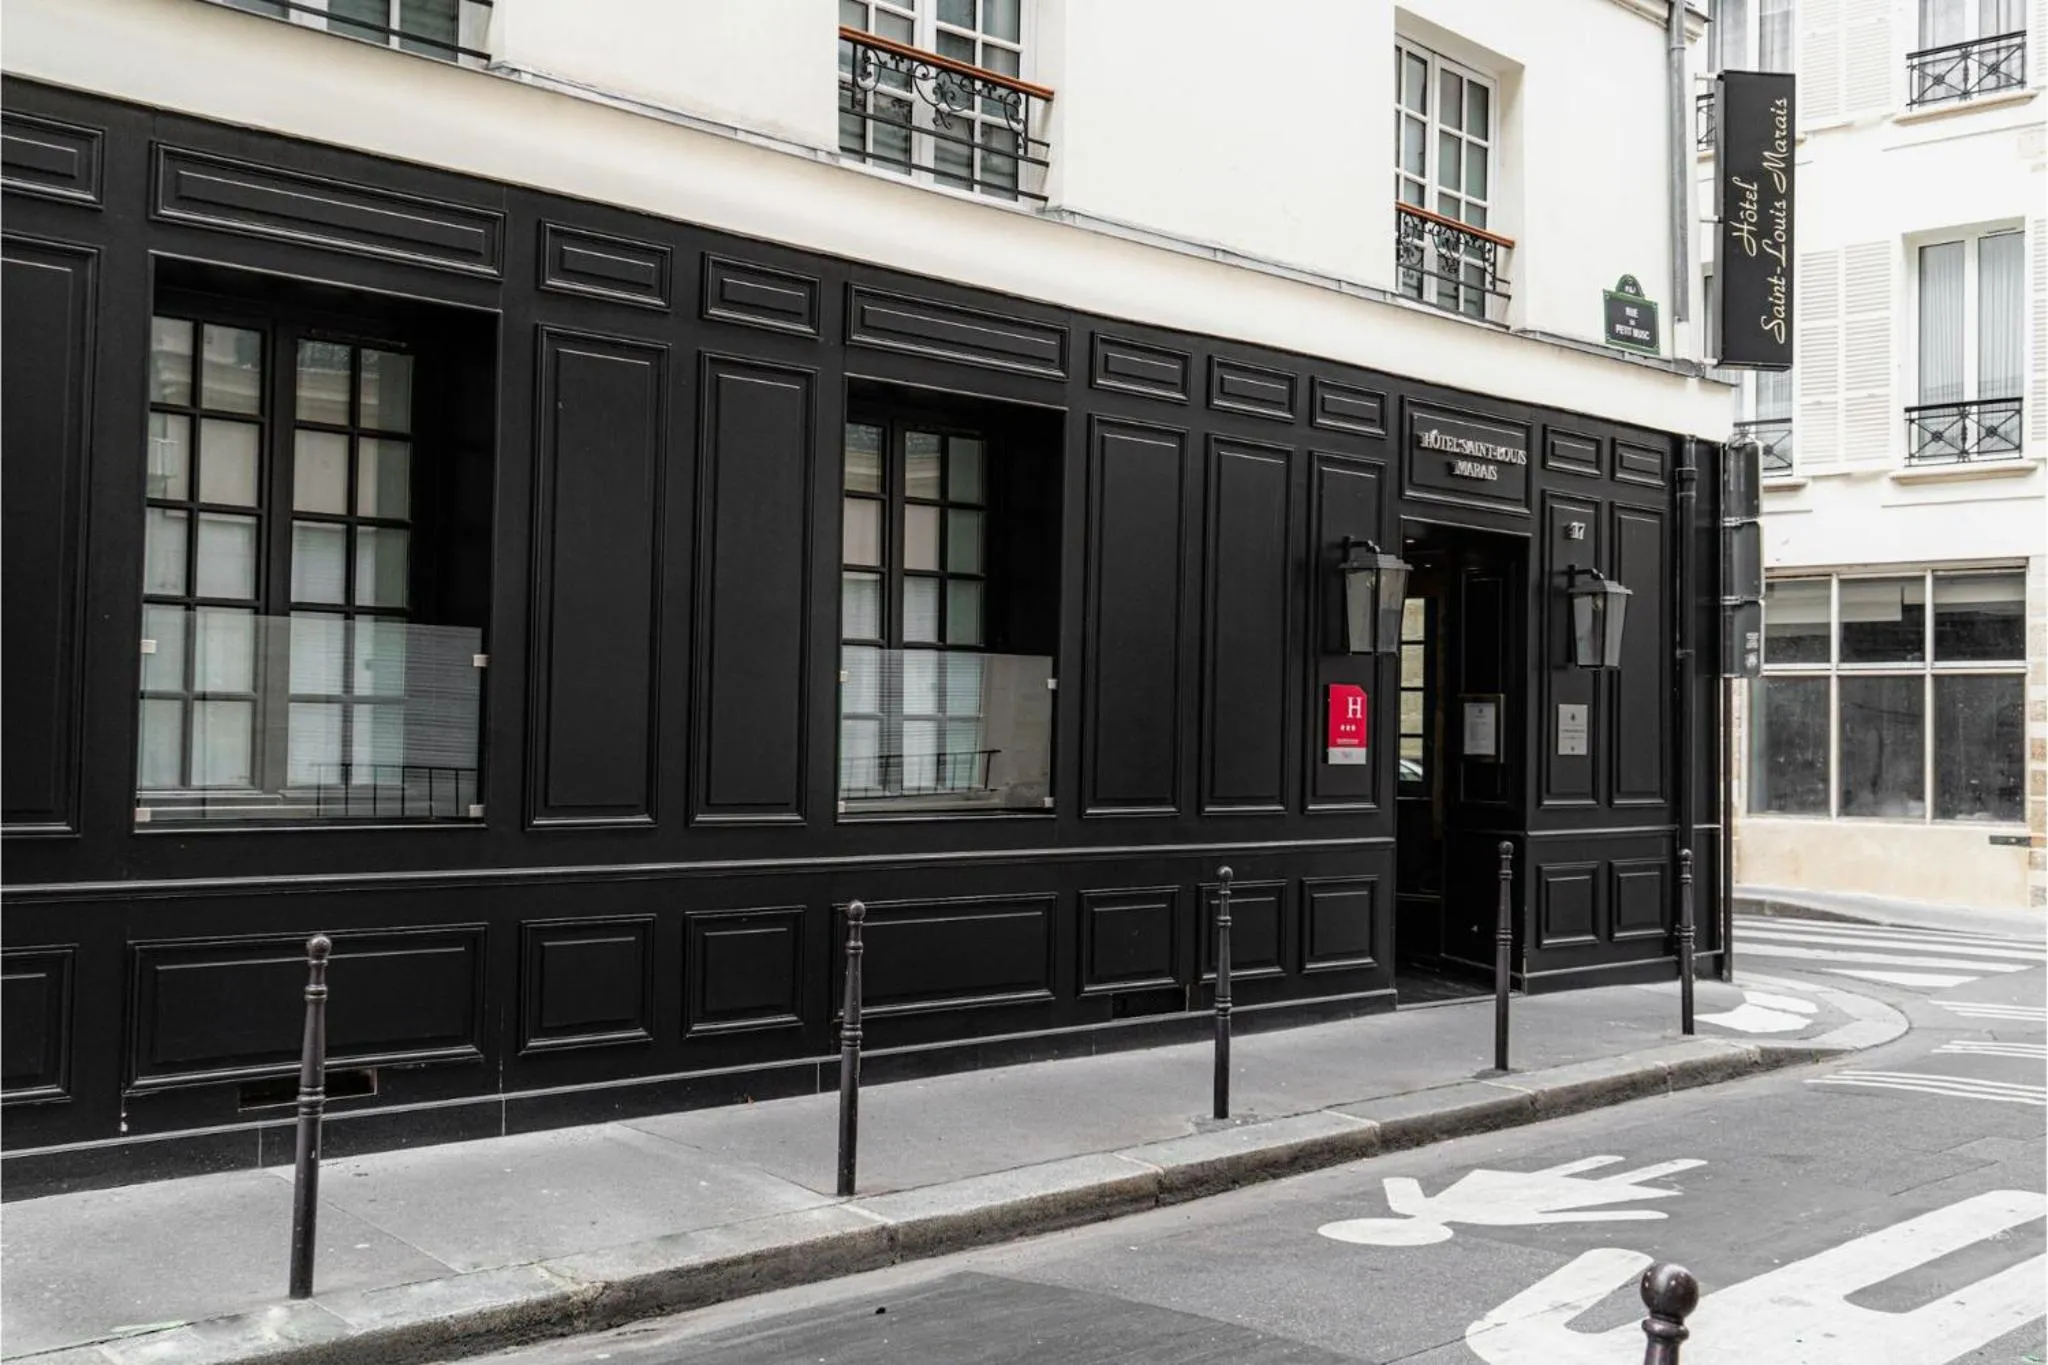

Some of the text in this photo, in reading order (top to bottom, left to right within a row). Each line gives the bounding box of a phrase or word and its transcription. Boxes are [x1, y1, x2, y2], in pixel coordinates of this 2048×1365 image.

[1732, 176, 1758, 257] Hôtel
[1761, 97, 1787, 344] Saint-Louis Marais
[1420, 429, 1527, 466] HÔTEL SAINT-LOUIS
[1453, 460, 1498, 480] MARAIS
[1346, 696, 1363, 719] H
